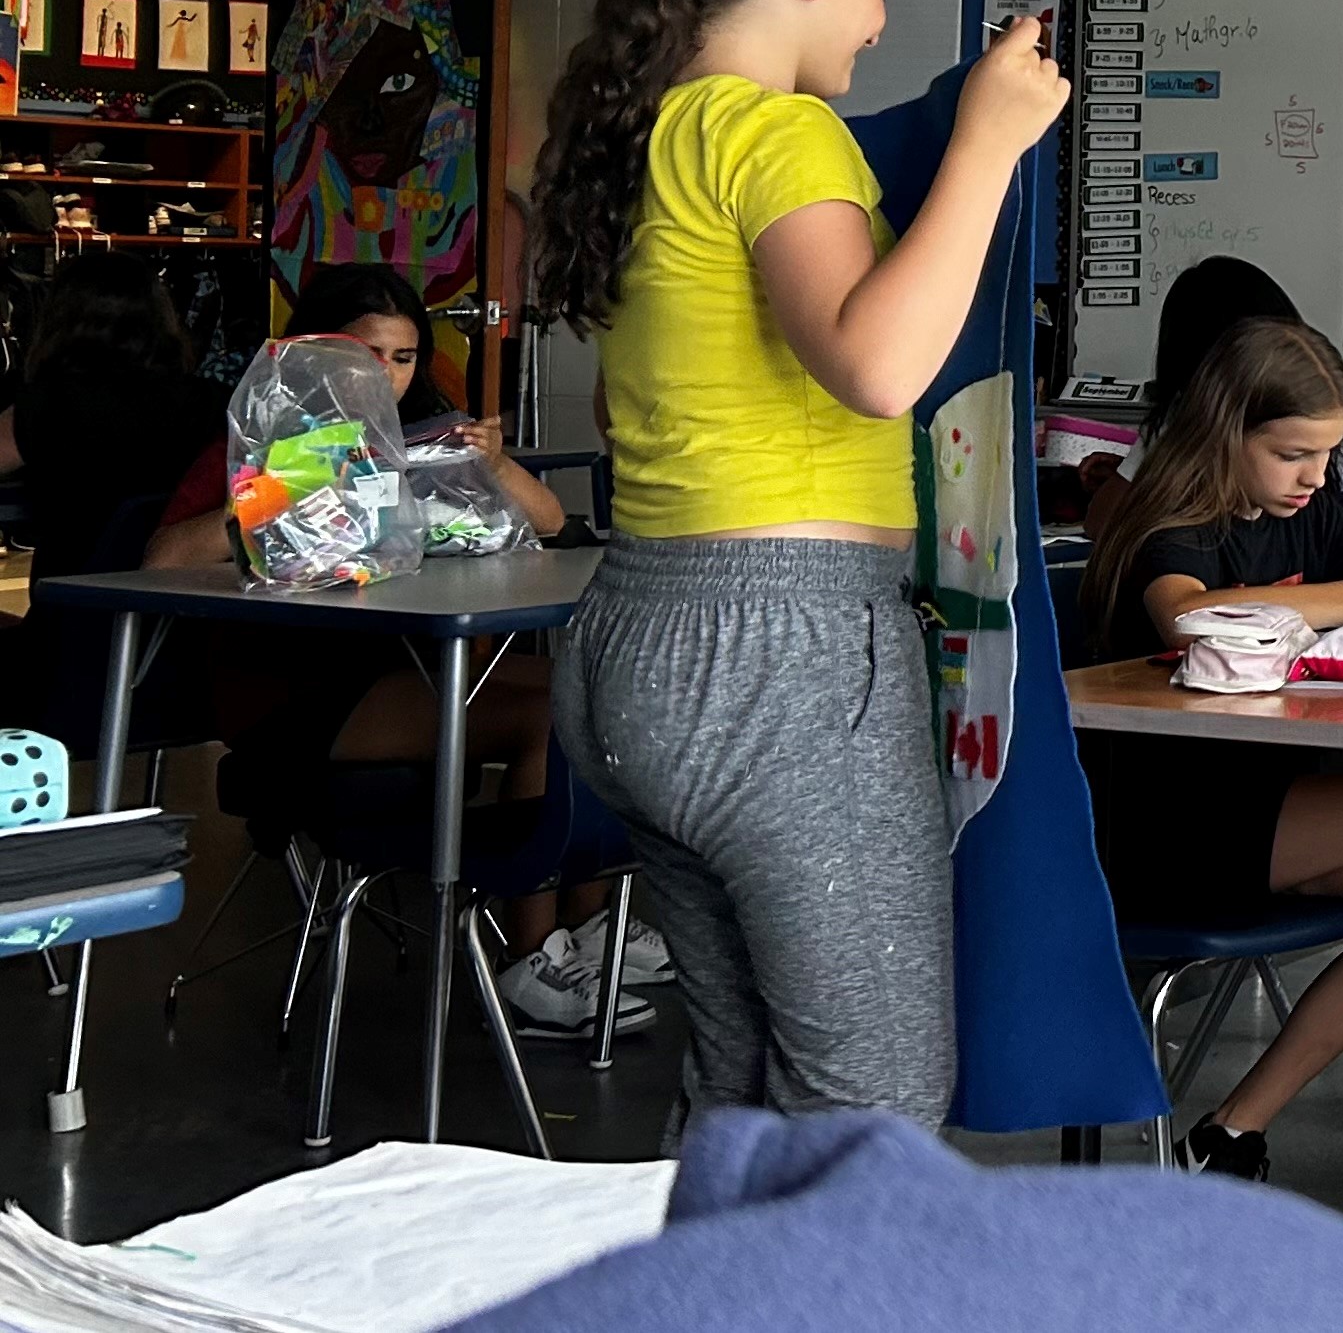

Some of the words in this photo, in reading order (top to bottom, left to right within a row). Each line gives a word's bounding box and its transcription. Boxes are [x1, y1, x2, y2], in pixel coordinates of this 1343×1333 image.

[1175, 15, 1218, 51] Math
[1153, 161, 1175, 173] Lunch
[1148, 185, 1196, 206] Recess
[1082, 386, 1129, 395] September
